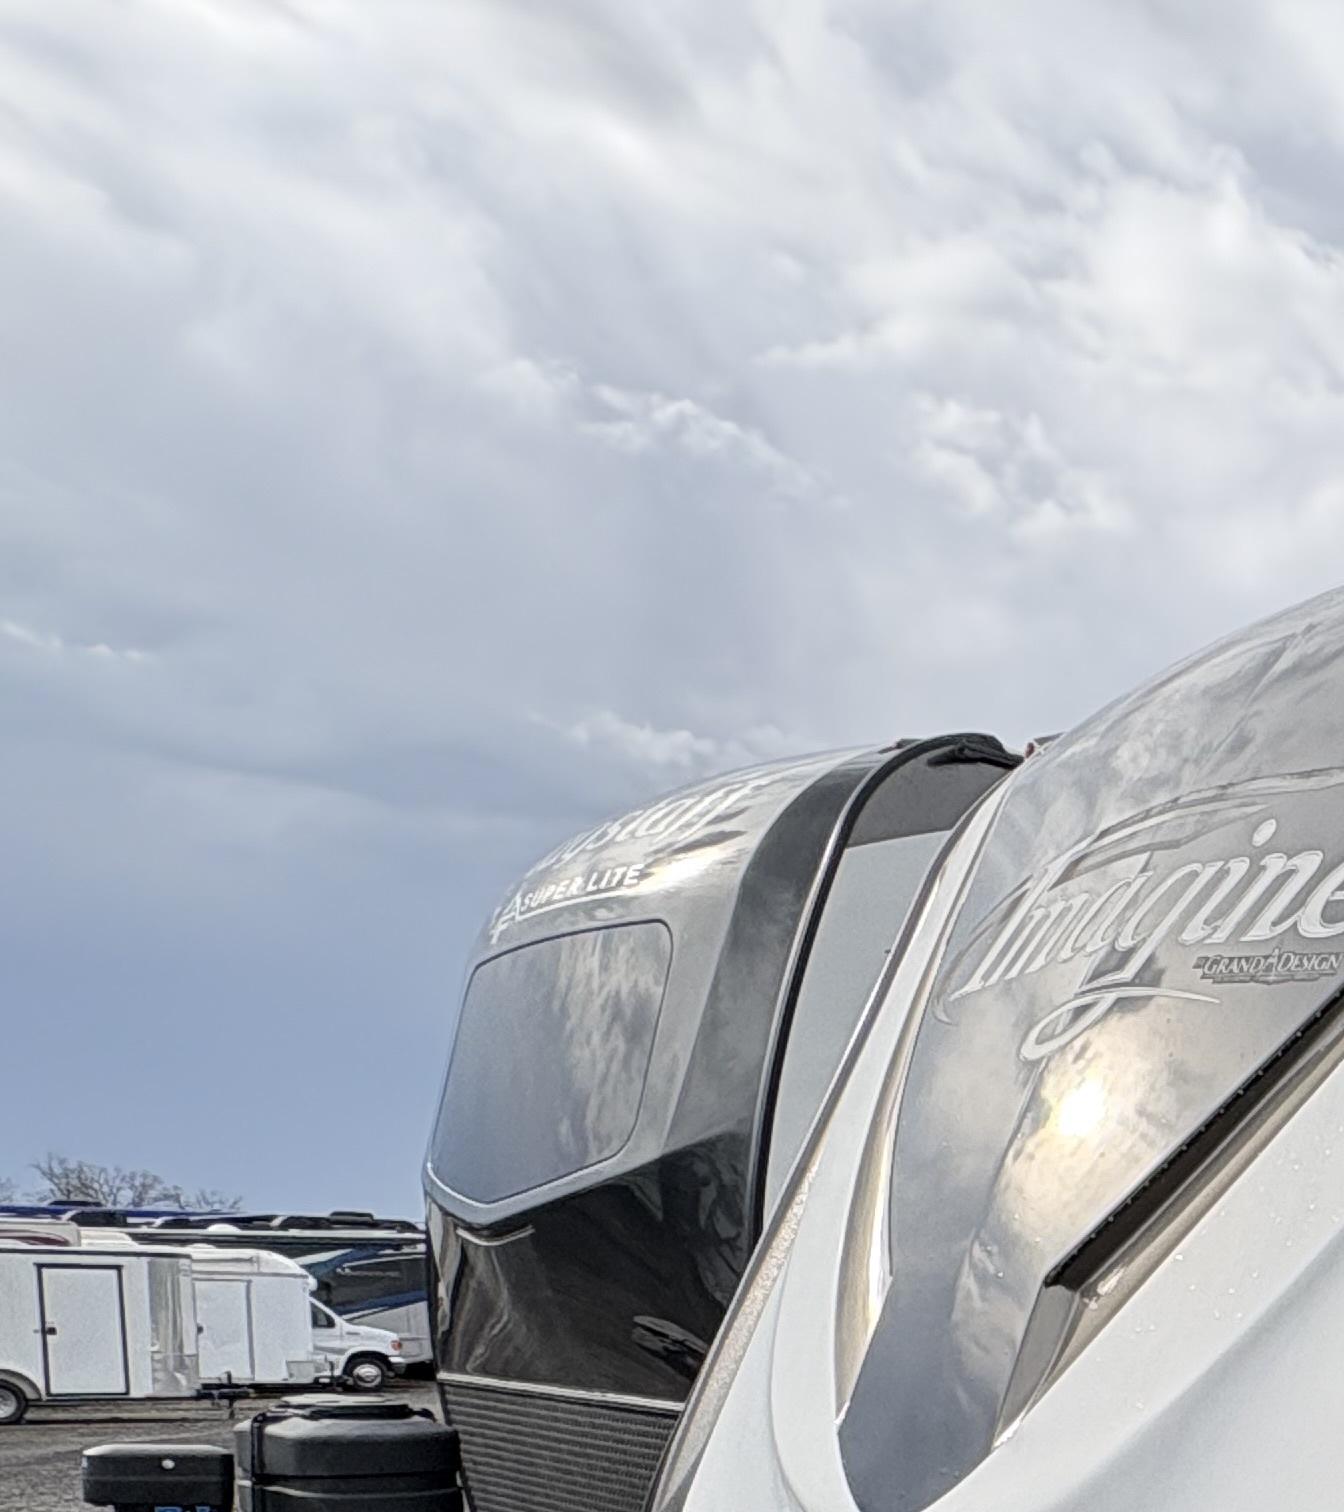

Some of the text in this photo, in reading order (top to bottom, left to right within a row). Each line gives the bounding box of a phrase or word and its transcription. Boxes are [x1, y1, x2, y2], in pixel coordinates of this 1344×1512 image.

[521, 863, 645, 910] SUPER LITE
[1203, 955, 1265, 976] GRAND
